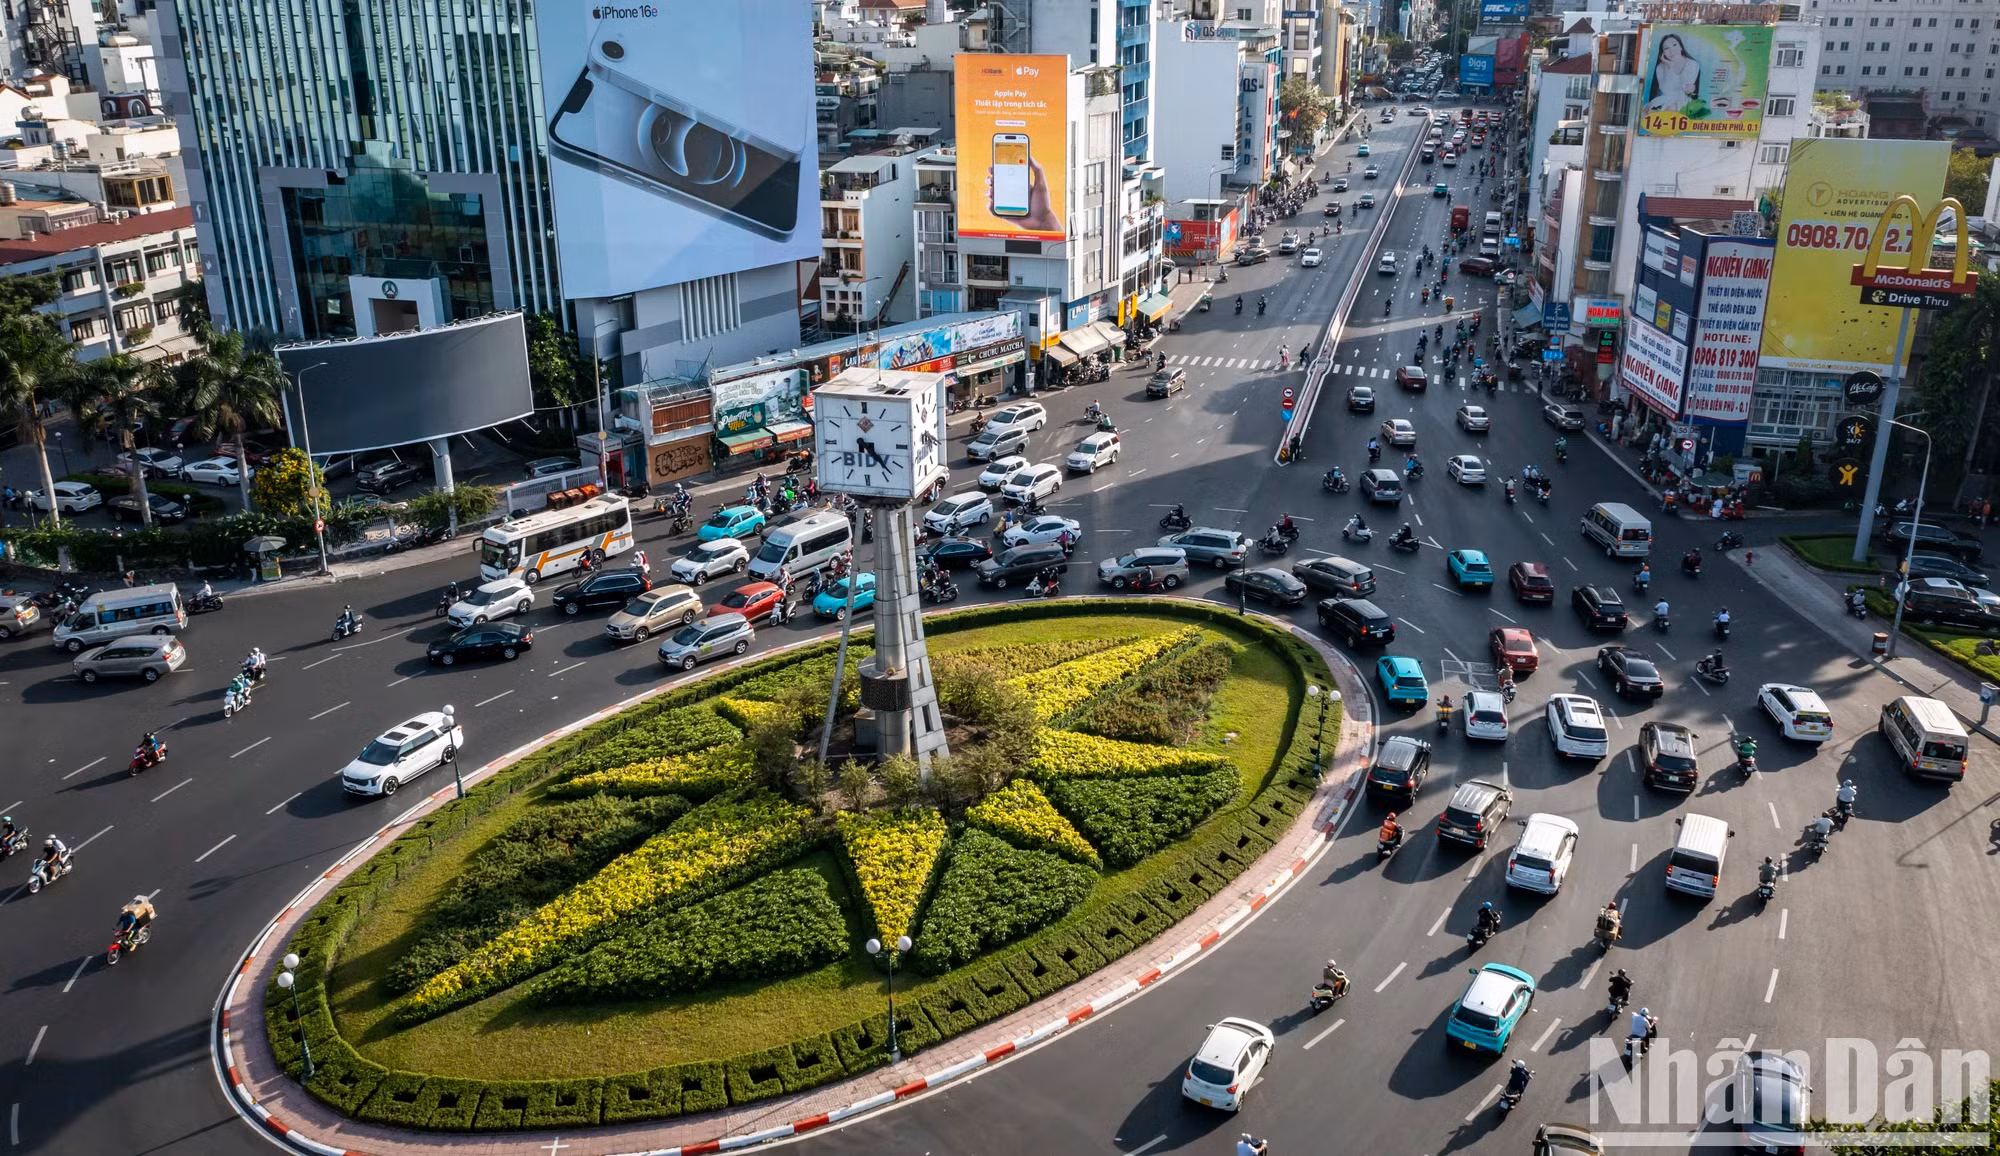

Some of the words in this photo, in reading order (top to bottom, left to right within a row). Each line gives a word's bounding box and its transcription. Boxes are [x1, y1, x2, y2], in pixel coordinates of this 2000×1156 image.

[602, 6, 638, 19] iPhone
[639, 5, 658, 18] 16e
[1202, 26, 1214, 37] QS
[1024, 66, 1039, 77] Pay
[1242, 78, 1257, 92] QS
[1014, 90, 1026, 98] Pay
[1645, 116, 1688, 130] 14-16
[1706, 249, 1743, 278] NGUYỄN
[1743, 258, 1771, 280] GIANG
[1875, 275, 1951, 288] McDonald's
[1888, 293, 1921, 304] Drive
[1924, 296, 1949, 306] Thru
[1746, 305, 1756, 315] LED
[1751, 322, 1760, 331] TAY
[1704, 333, 1751, 343] HOTLINE:
[1000, 340, 1024, 353] MATCHA
[1694, 347, 1717, 366] 0906
[1719, 348, 1737, 367] 819
[1738, 350, 1756, 368] 300
[1625, 354, 1655, 385] NGUYỄN
[1656, 374, 1679, 400] GIANG
